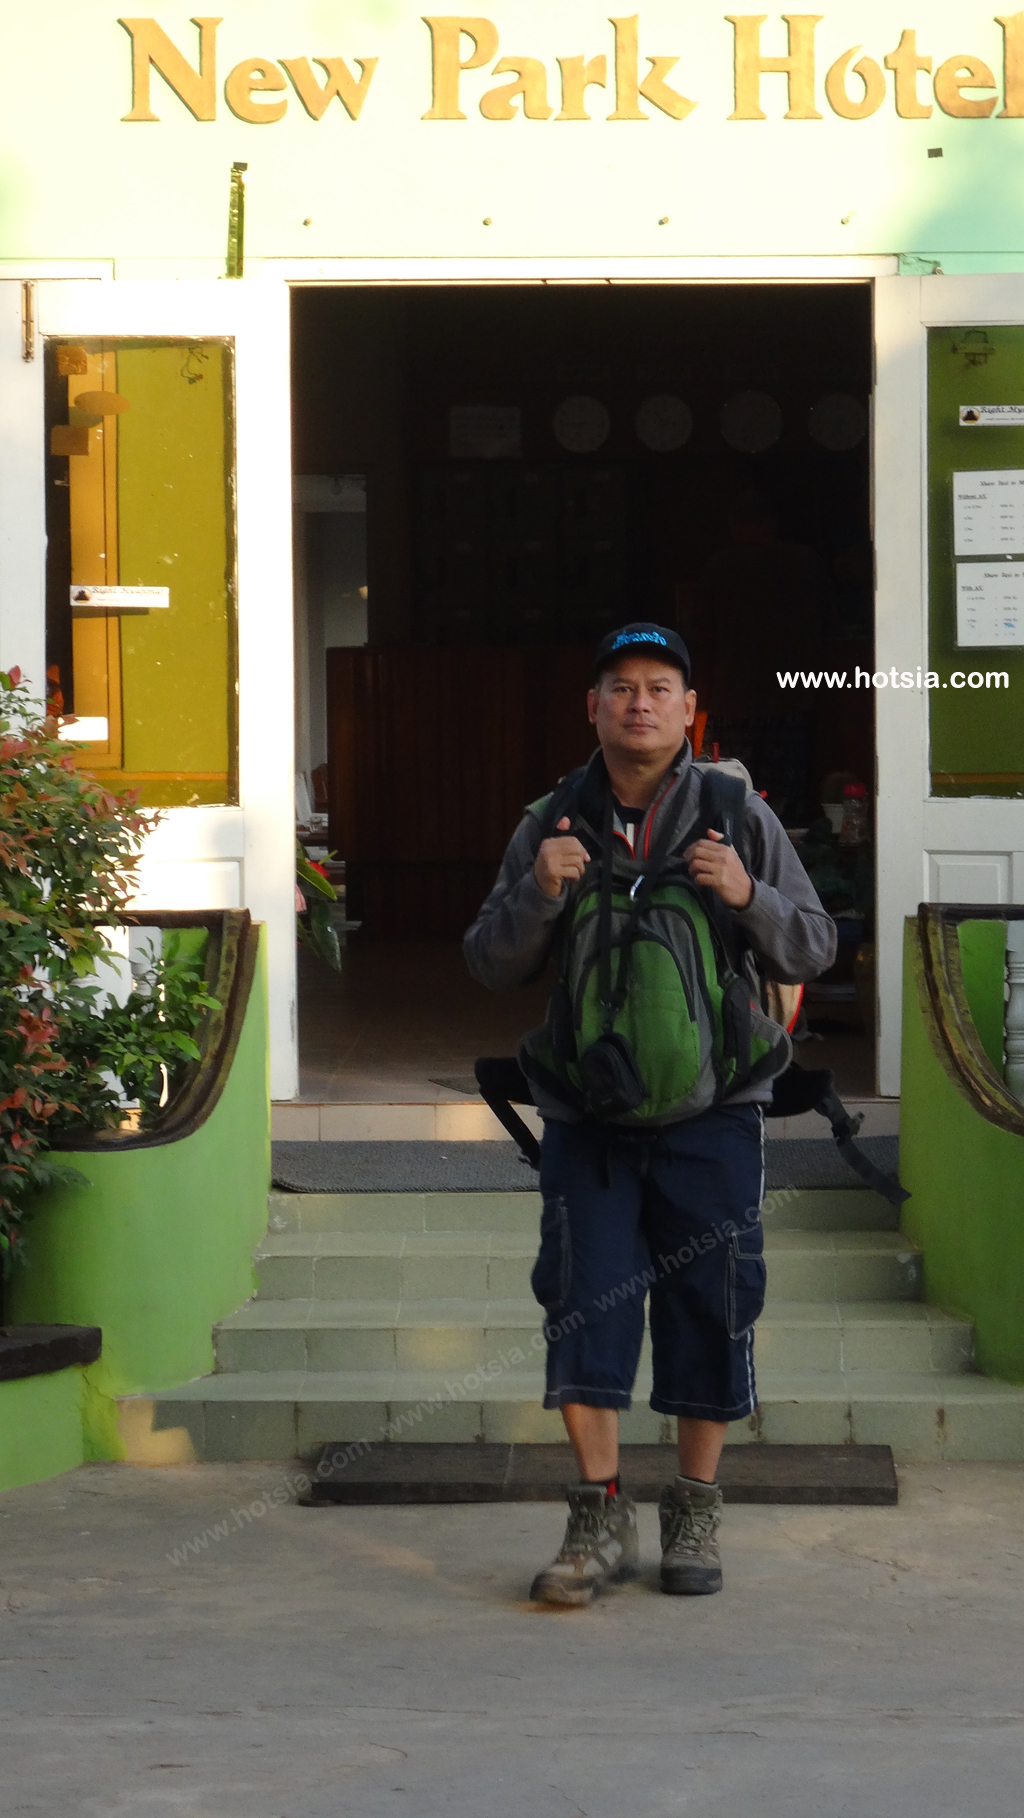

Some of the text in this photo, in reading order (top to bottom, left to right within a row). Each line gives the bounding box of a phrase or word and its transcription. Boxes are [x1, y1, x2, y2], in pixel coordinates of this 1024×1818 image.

[117, 10, 1024, 124] New Park Hotel
